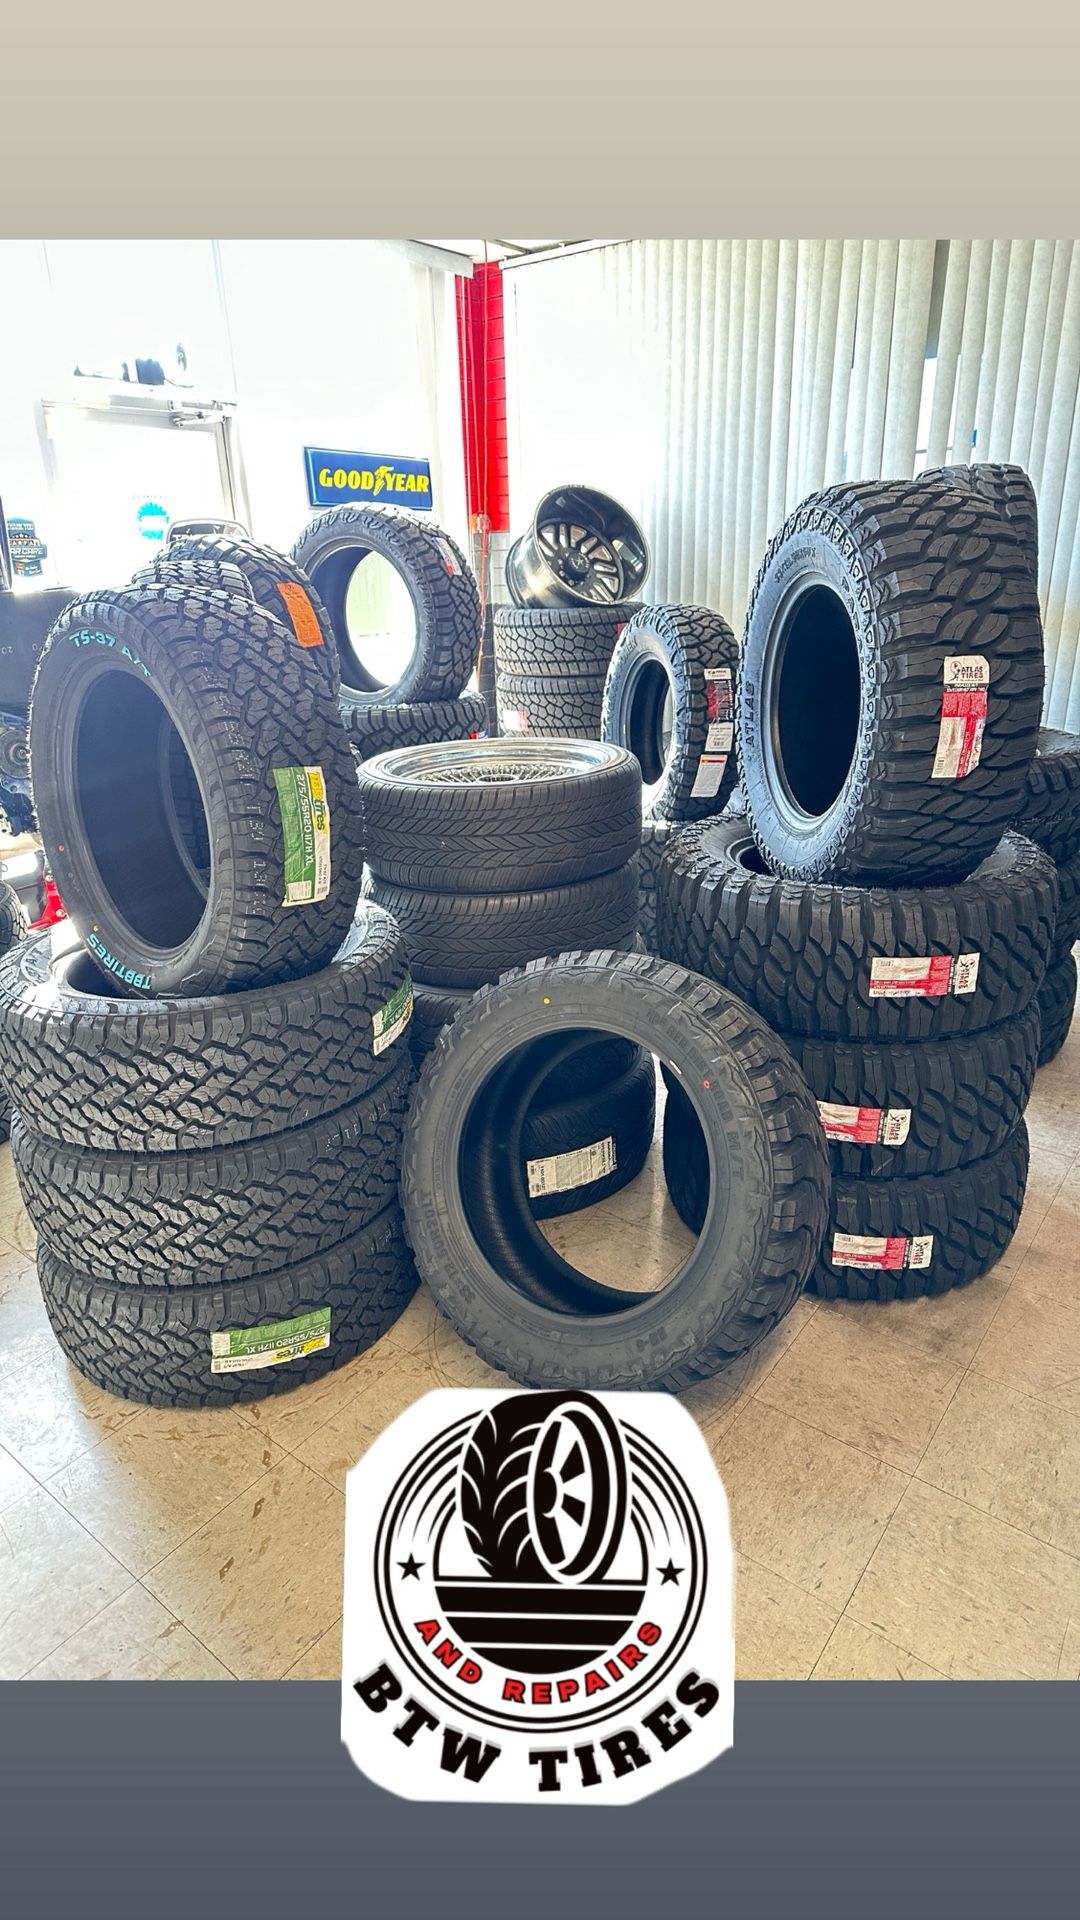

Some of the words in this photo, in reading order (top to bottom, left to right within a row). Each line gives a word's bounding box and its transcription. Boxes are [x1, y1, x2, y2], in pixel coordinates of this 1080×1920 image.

[319, 466, 429, 495] GOODYEAR
[69, 630, 116, 648] TS-37
[745, 682, 755, 748] ATLAS
[296, 774, 312, 832] 275/55R20
[87, 933, 152, 990] TBBTIRES
[276, 1326, 326, 1347] 275/55R20
